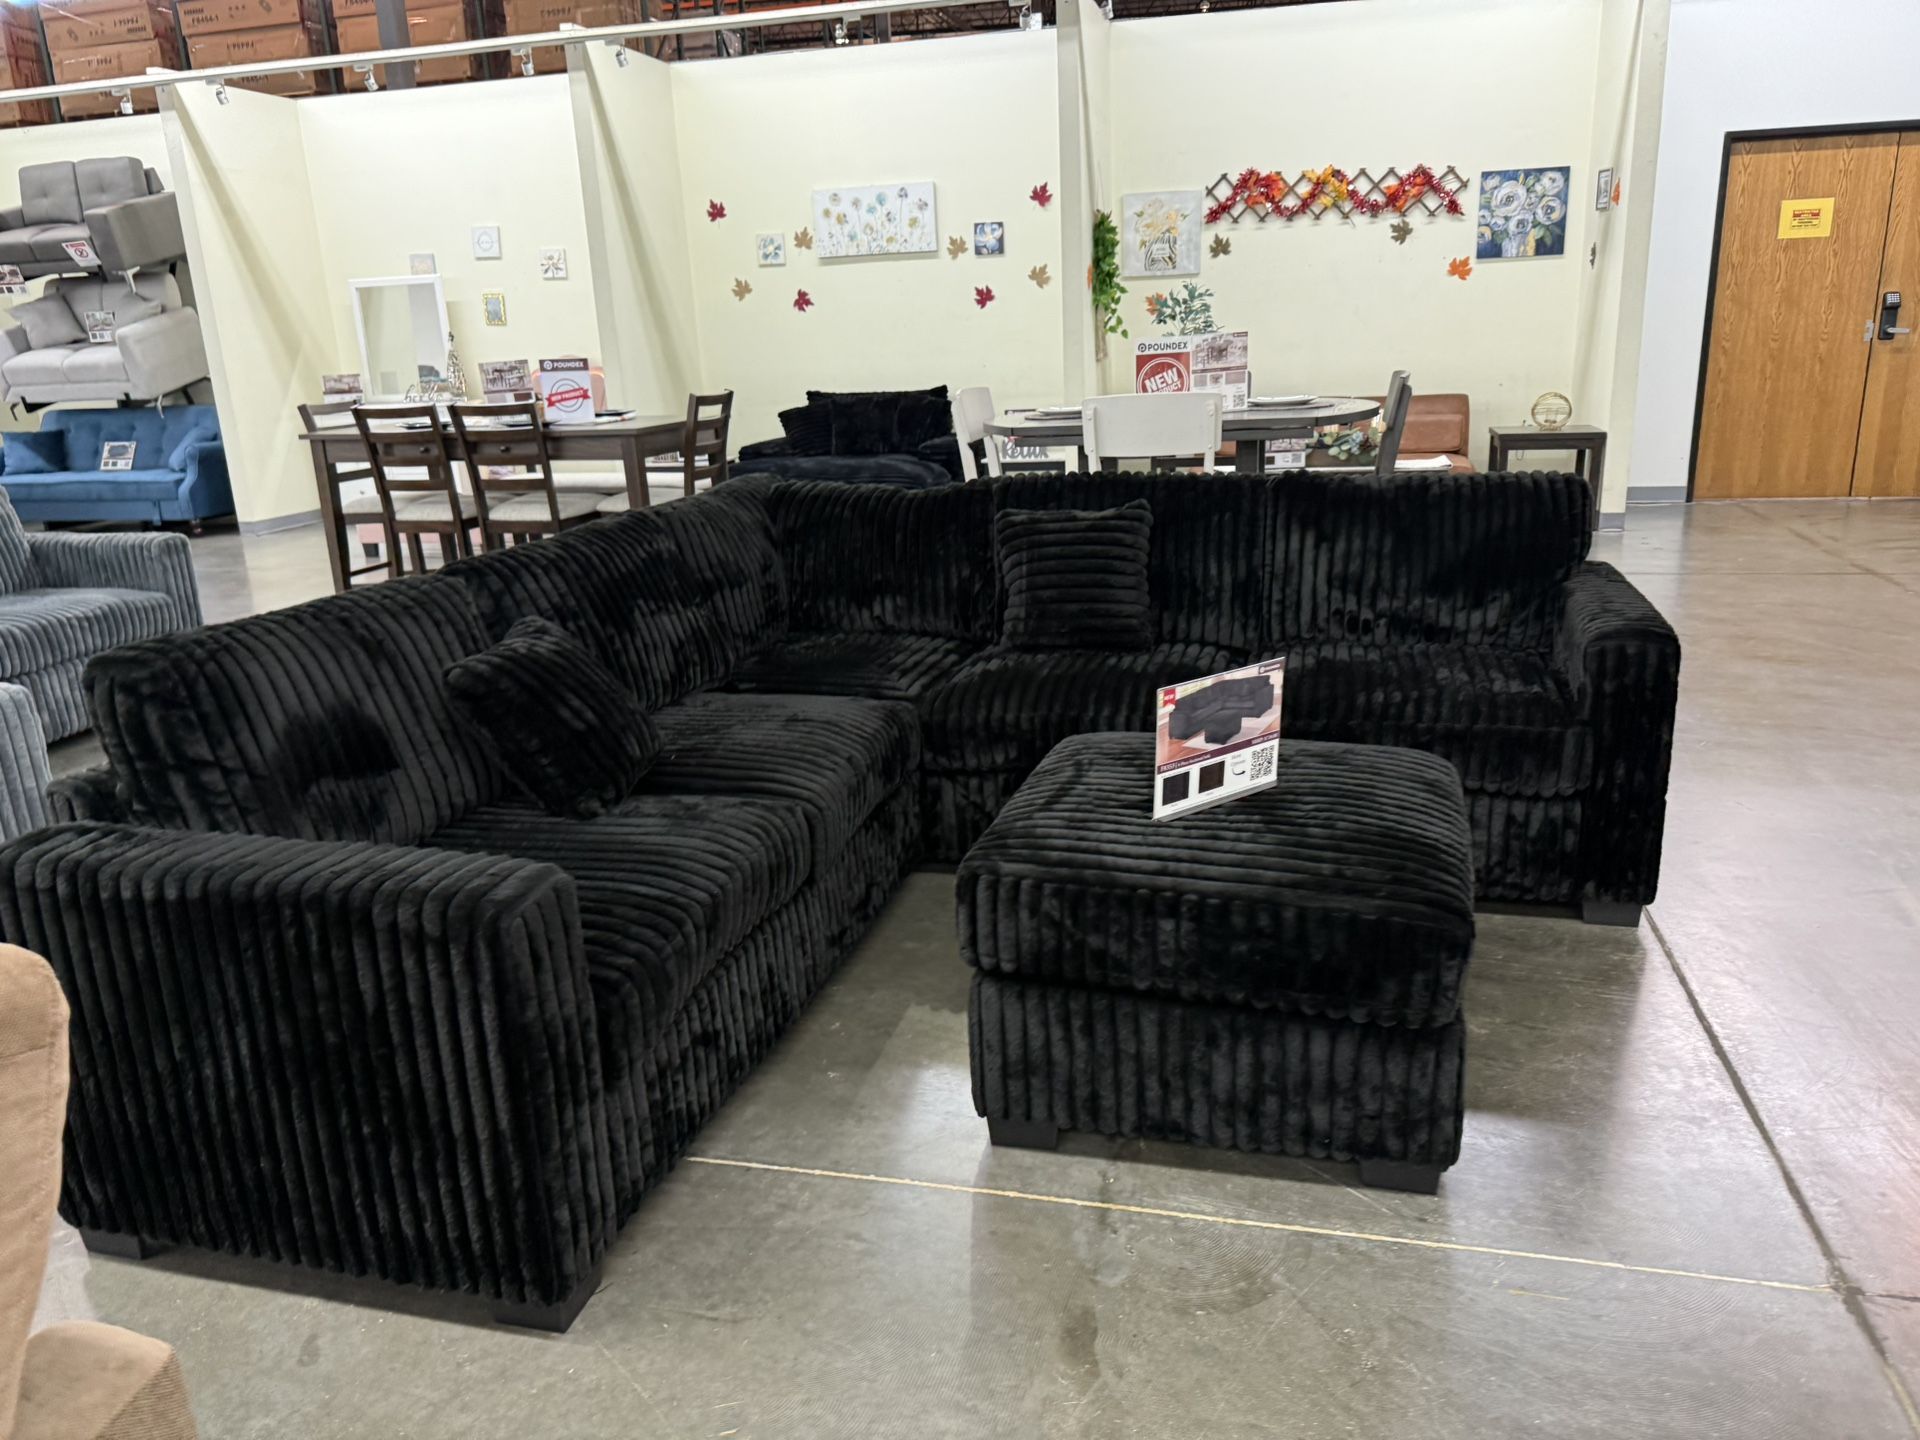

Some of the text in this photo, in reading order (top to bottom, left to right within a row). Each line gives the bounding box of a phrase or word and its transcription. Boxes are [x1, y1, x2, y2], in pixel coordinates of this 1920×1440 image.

[1148, 342, 1188, 352] POUNDEX
[553, 361, 584, 369] POUNDEX
[1144, 366, 1180, 393] NEW
